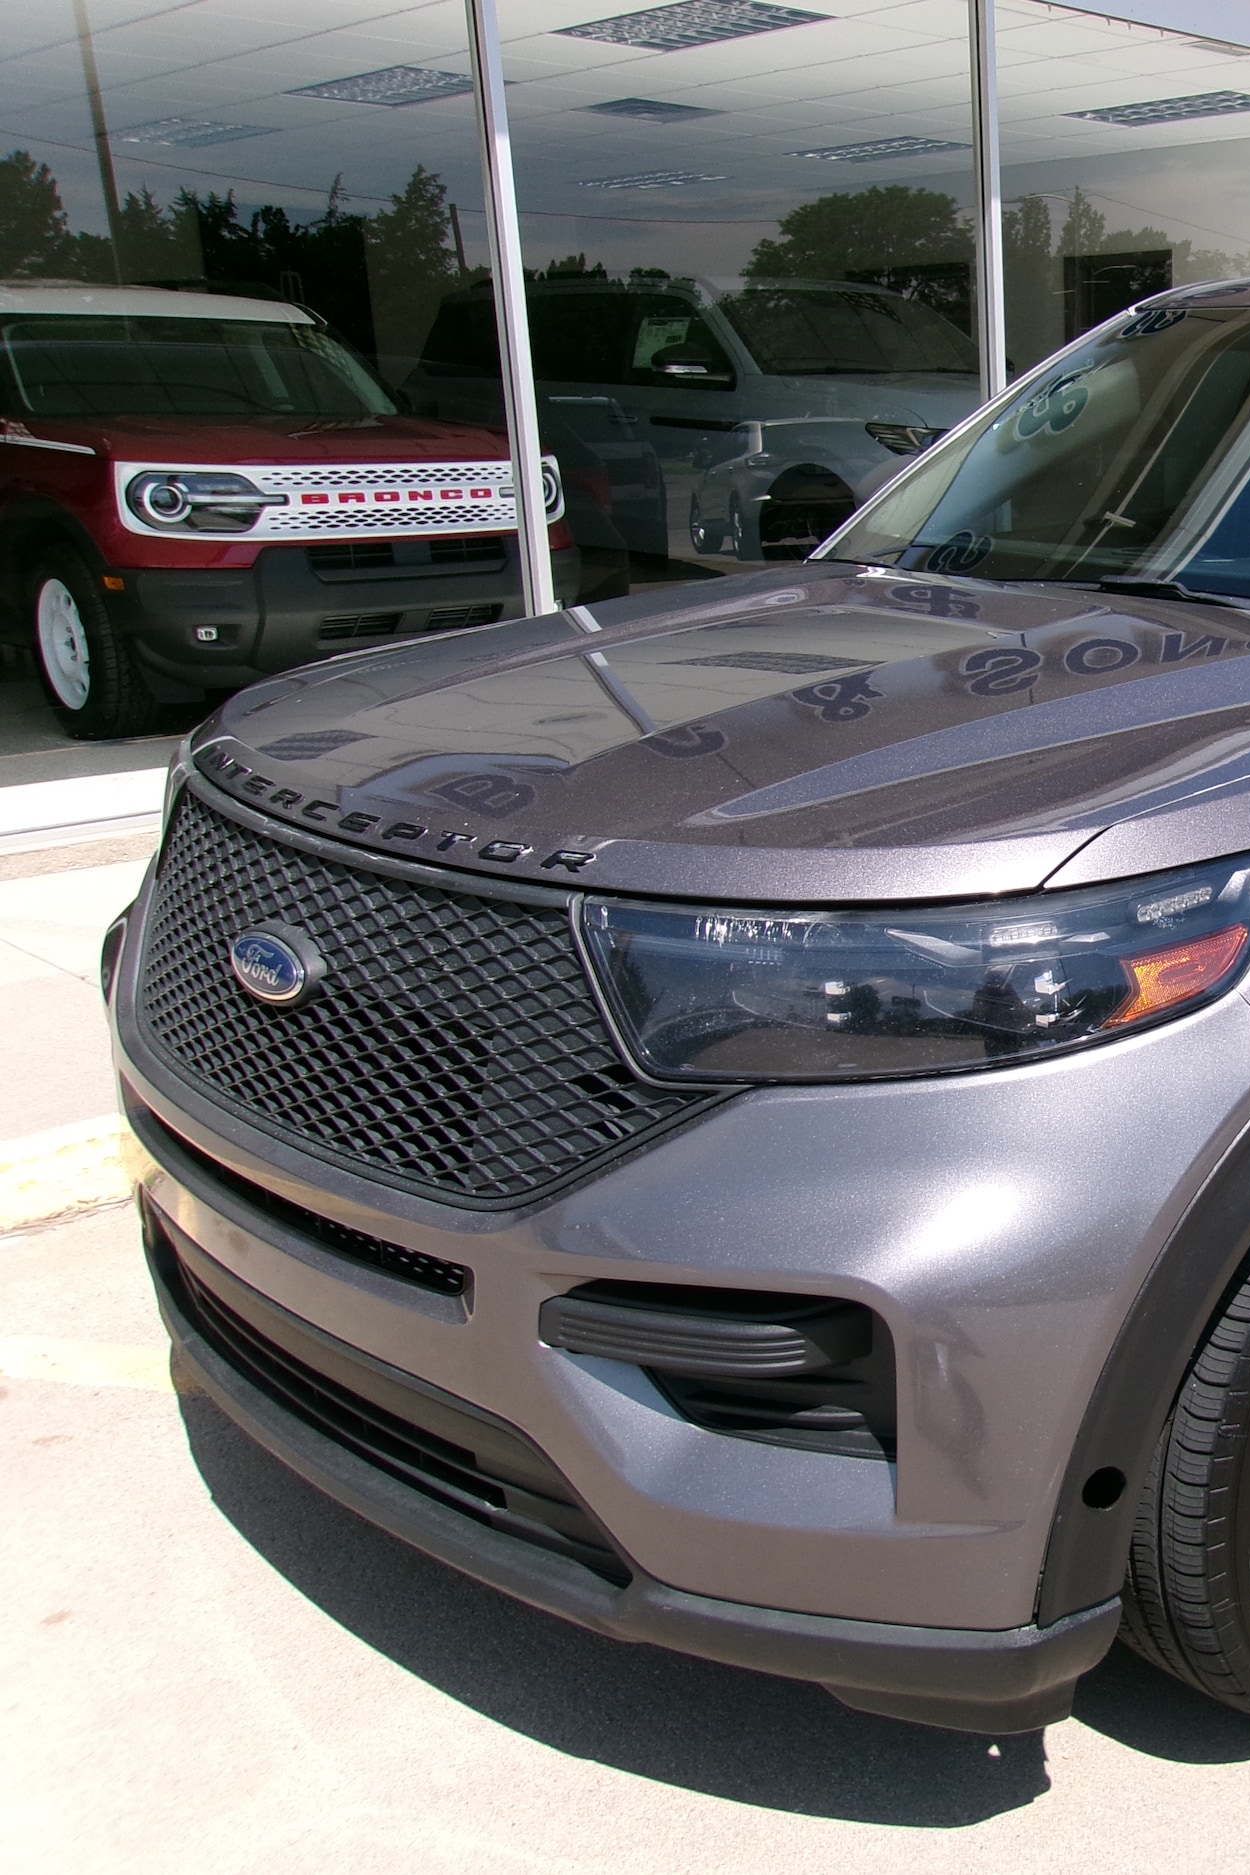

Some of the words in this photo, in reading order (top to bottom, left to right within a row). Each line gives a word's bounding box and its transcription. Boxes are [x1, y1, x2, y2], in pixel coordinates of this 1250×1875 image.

[301, 488, 493, 505] BRONCO
[202, 746, 598, 873] INTERCEPTOR
[241, 943, 283, 986] Ford
